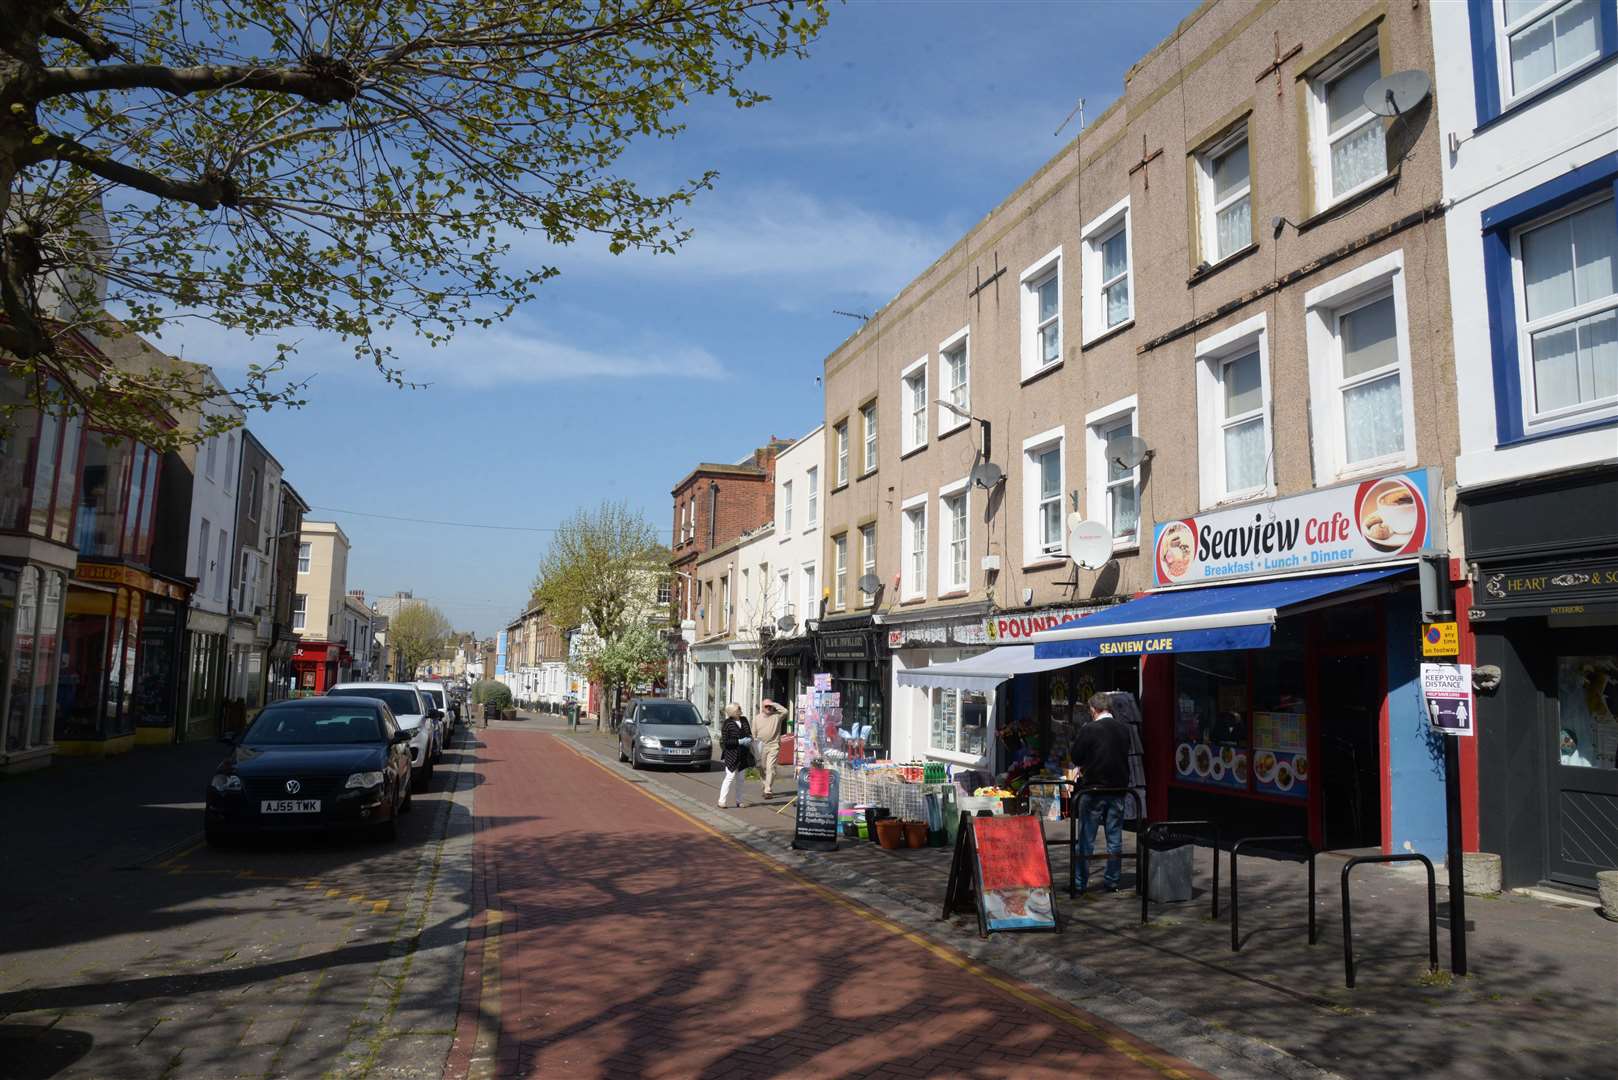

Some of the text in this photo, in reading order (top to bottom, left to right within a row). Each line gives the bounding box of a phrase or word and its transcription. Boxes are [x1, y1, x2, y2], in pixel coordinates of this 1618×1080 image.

[1199, 511, 1350, 562] Seaview Cafe
[1204, 548, 1354, 577] Breakfast Lunch Dinner
[1507, 576, 1548, 591] HEART
[1591, 572, 1601, 584] &
[1100, 638, 1173, 654] SEAVIEW CAFE
[266, 801, 316, 811] AJ55 TWK
